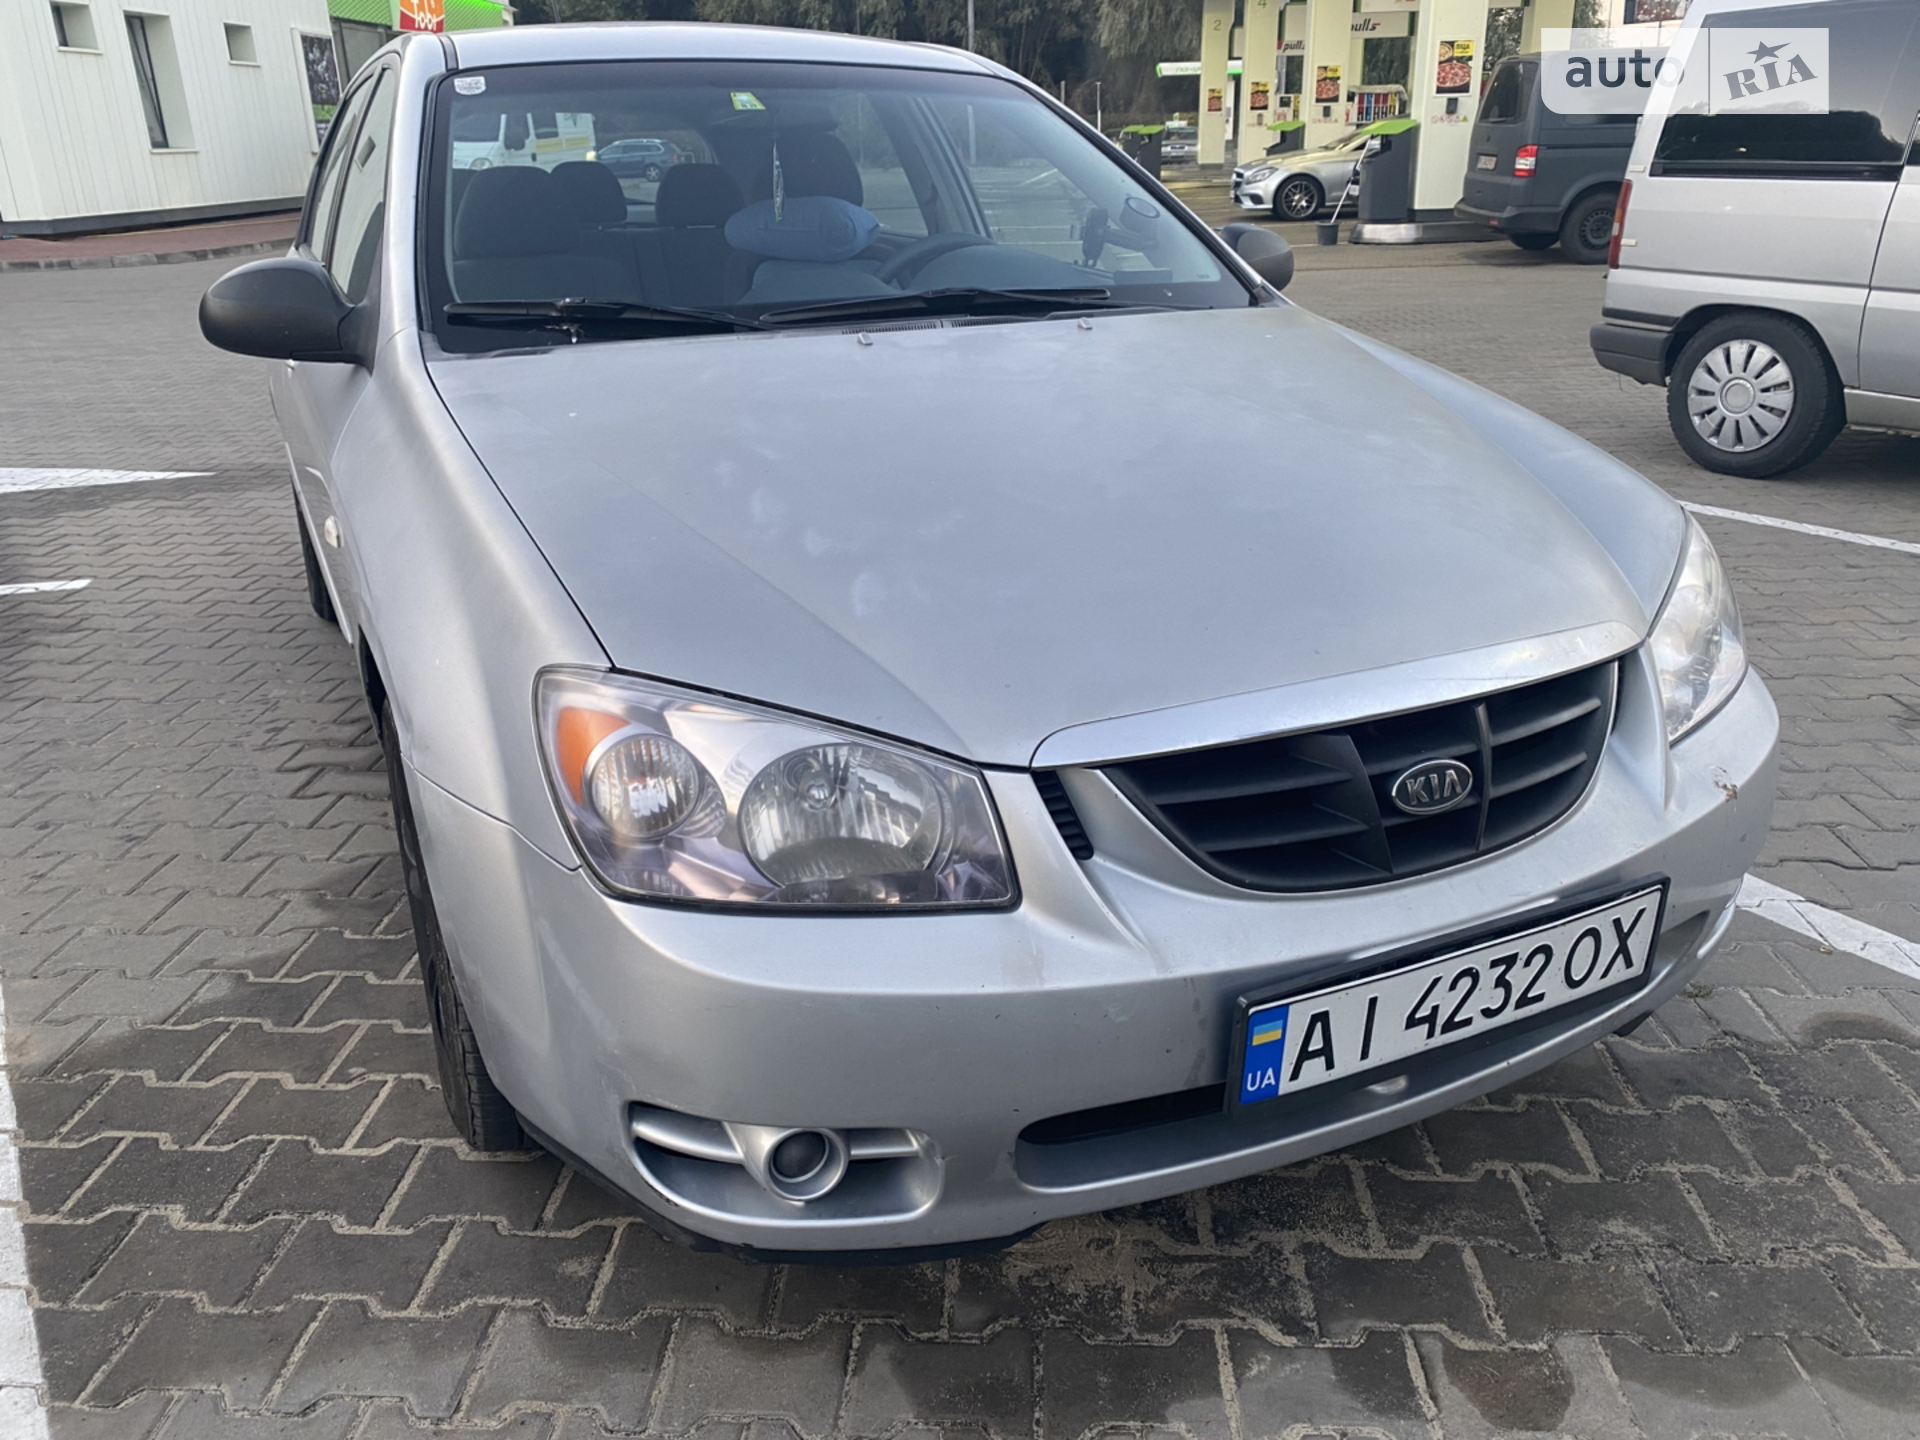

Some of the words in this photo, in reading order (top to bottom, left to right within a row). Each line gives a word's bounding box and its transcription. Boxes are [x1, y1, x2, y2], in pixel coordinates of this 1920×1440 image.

[1213, 20, 1221, 31] 2
[1404, 768, 1462, 805] KIA
[1288, 996, 1377, 1083] AI
[1404, 943, 1555, 1040] 4232
[1563, 906, 1647, 990] OX
[1246, 1066, 1276, 1092] UA
